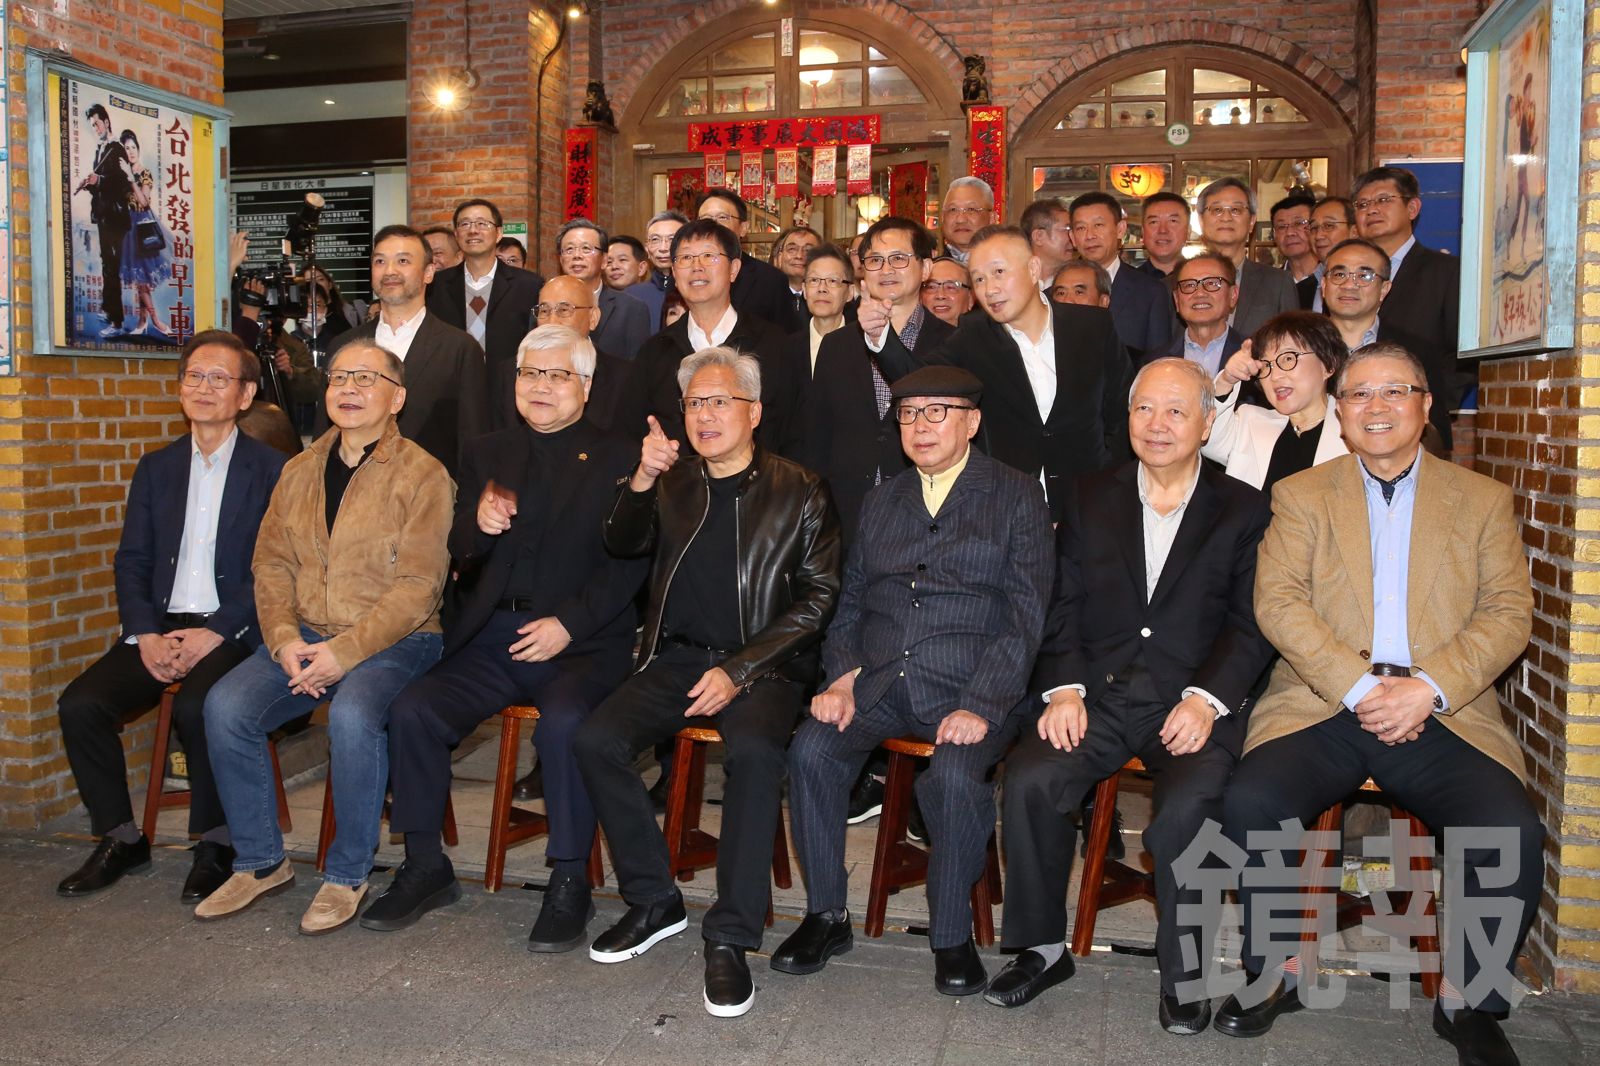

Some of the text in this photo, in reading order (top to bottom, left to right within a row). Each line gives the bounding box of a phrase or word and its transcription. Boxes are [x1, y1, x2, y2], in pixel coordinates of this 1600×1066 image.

[165, 116, 194, 345] 台北發的早車
